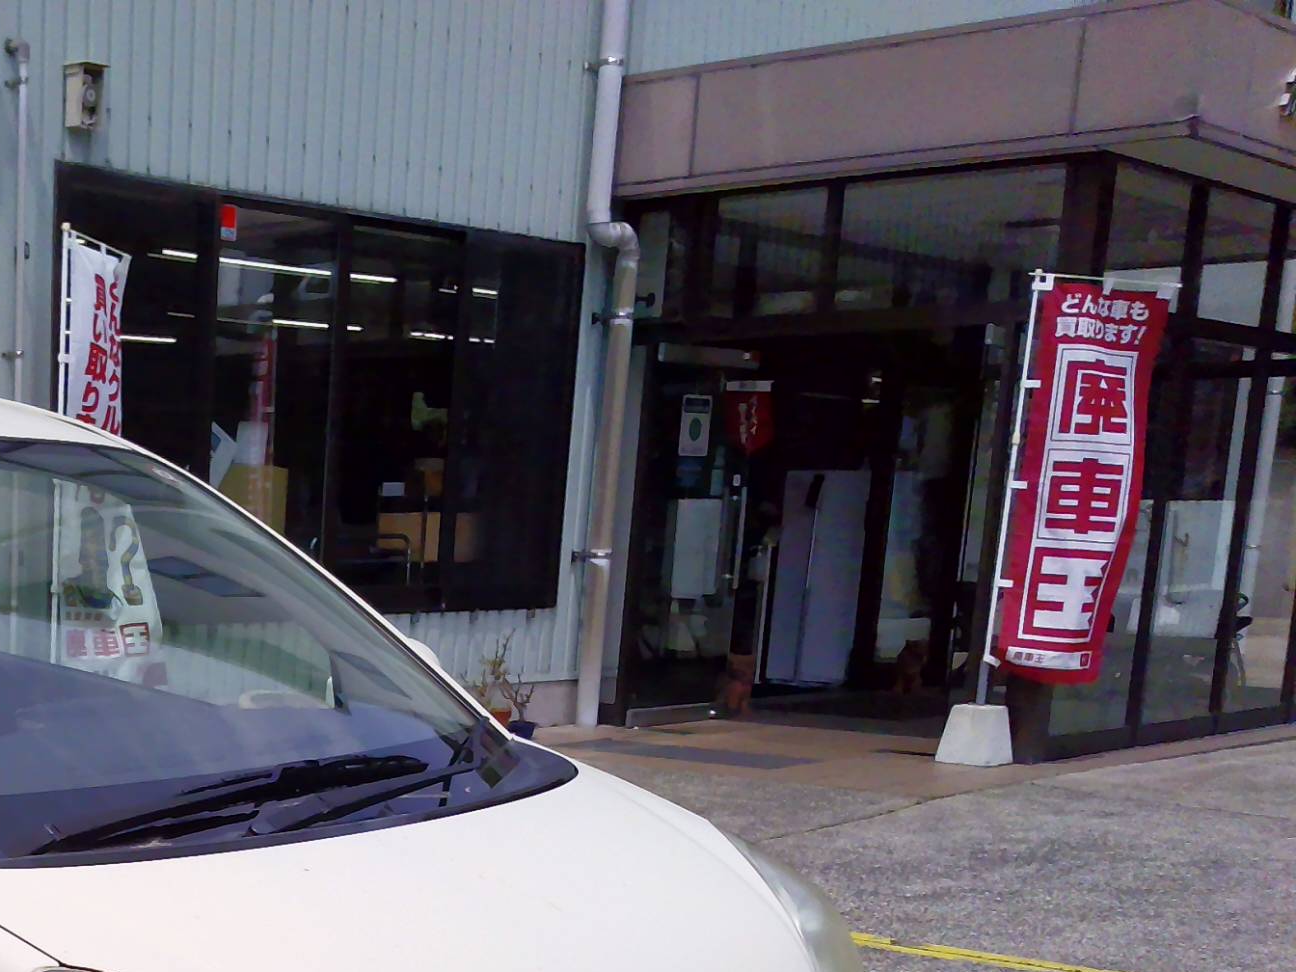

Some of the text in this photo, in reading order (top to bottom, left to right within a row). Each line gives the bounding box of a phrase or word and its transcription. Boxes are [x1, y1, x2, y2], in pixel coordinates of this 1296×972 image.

[1061, 294, 1149, 320] どんな車も
[1032, 359, 1128, 631] 廃車王
